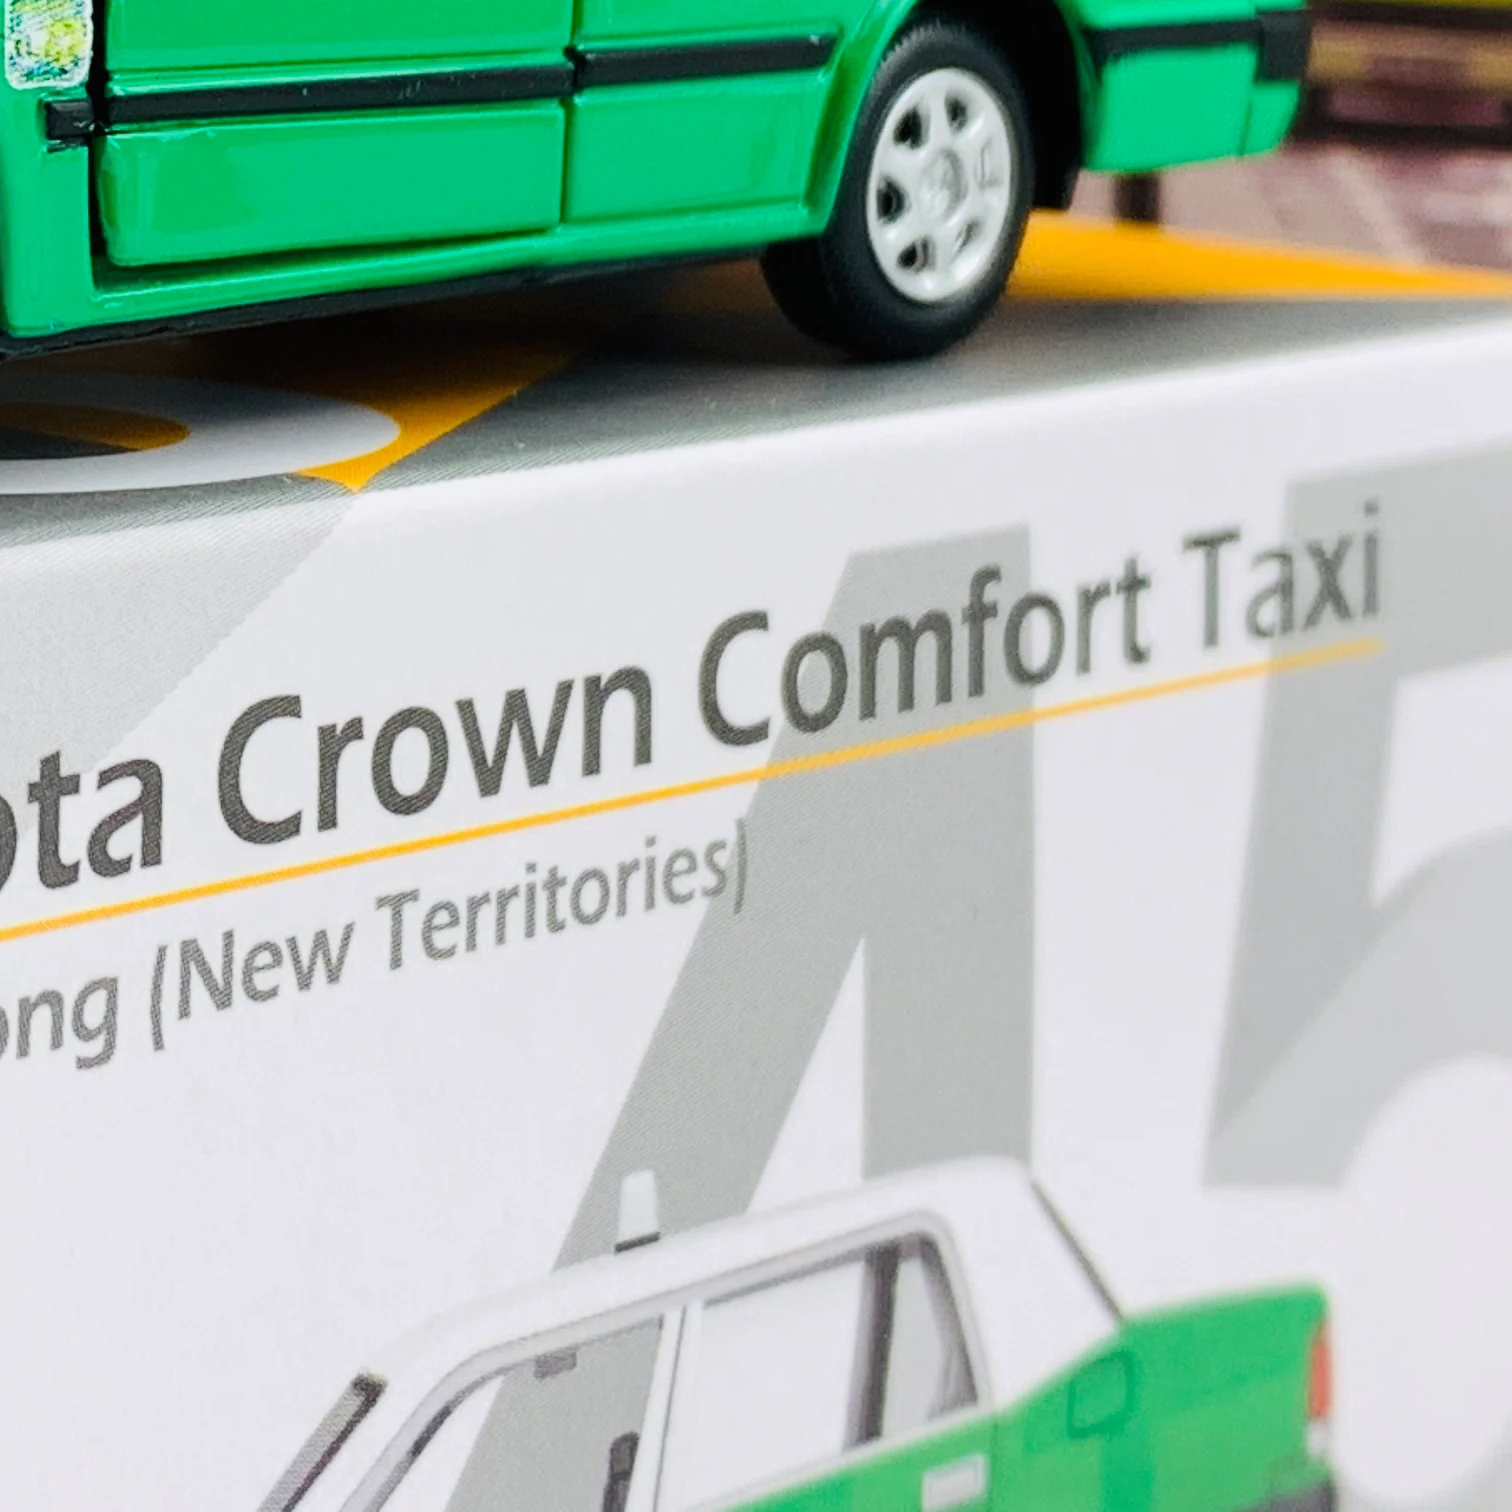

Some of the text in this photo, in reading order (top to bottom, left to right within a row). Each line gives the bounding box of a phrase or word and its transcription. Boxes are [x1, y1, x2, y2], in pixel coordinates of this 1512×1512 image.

[217, 664, 653, 846] Crown
[697, 563, 1152, 749] Comfort
[1181, 498, 1382, 650] Taxi
[148, 922, 356, 1052] (New
[376, 817, 749, 971] Territories)
